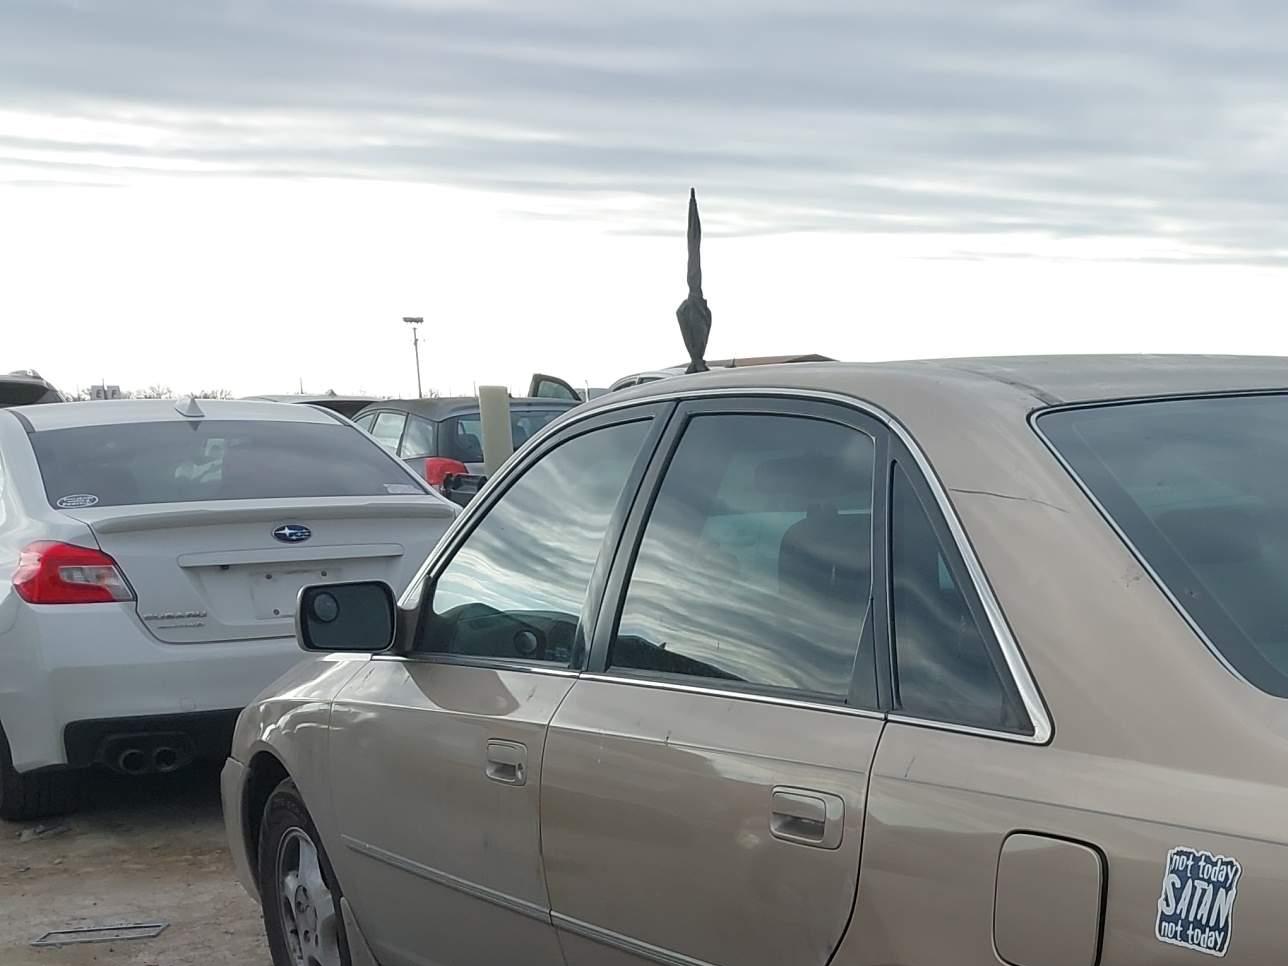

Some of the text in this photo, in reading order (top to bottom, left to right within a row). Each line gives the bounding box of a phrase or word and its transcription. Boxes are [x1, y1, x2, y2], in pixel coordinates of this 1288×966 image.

[1171, 854, 1236, 887] not today
[1161, 873, 1236, 929] SATAN
[1161, 920, 1225, 951] not today
